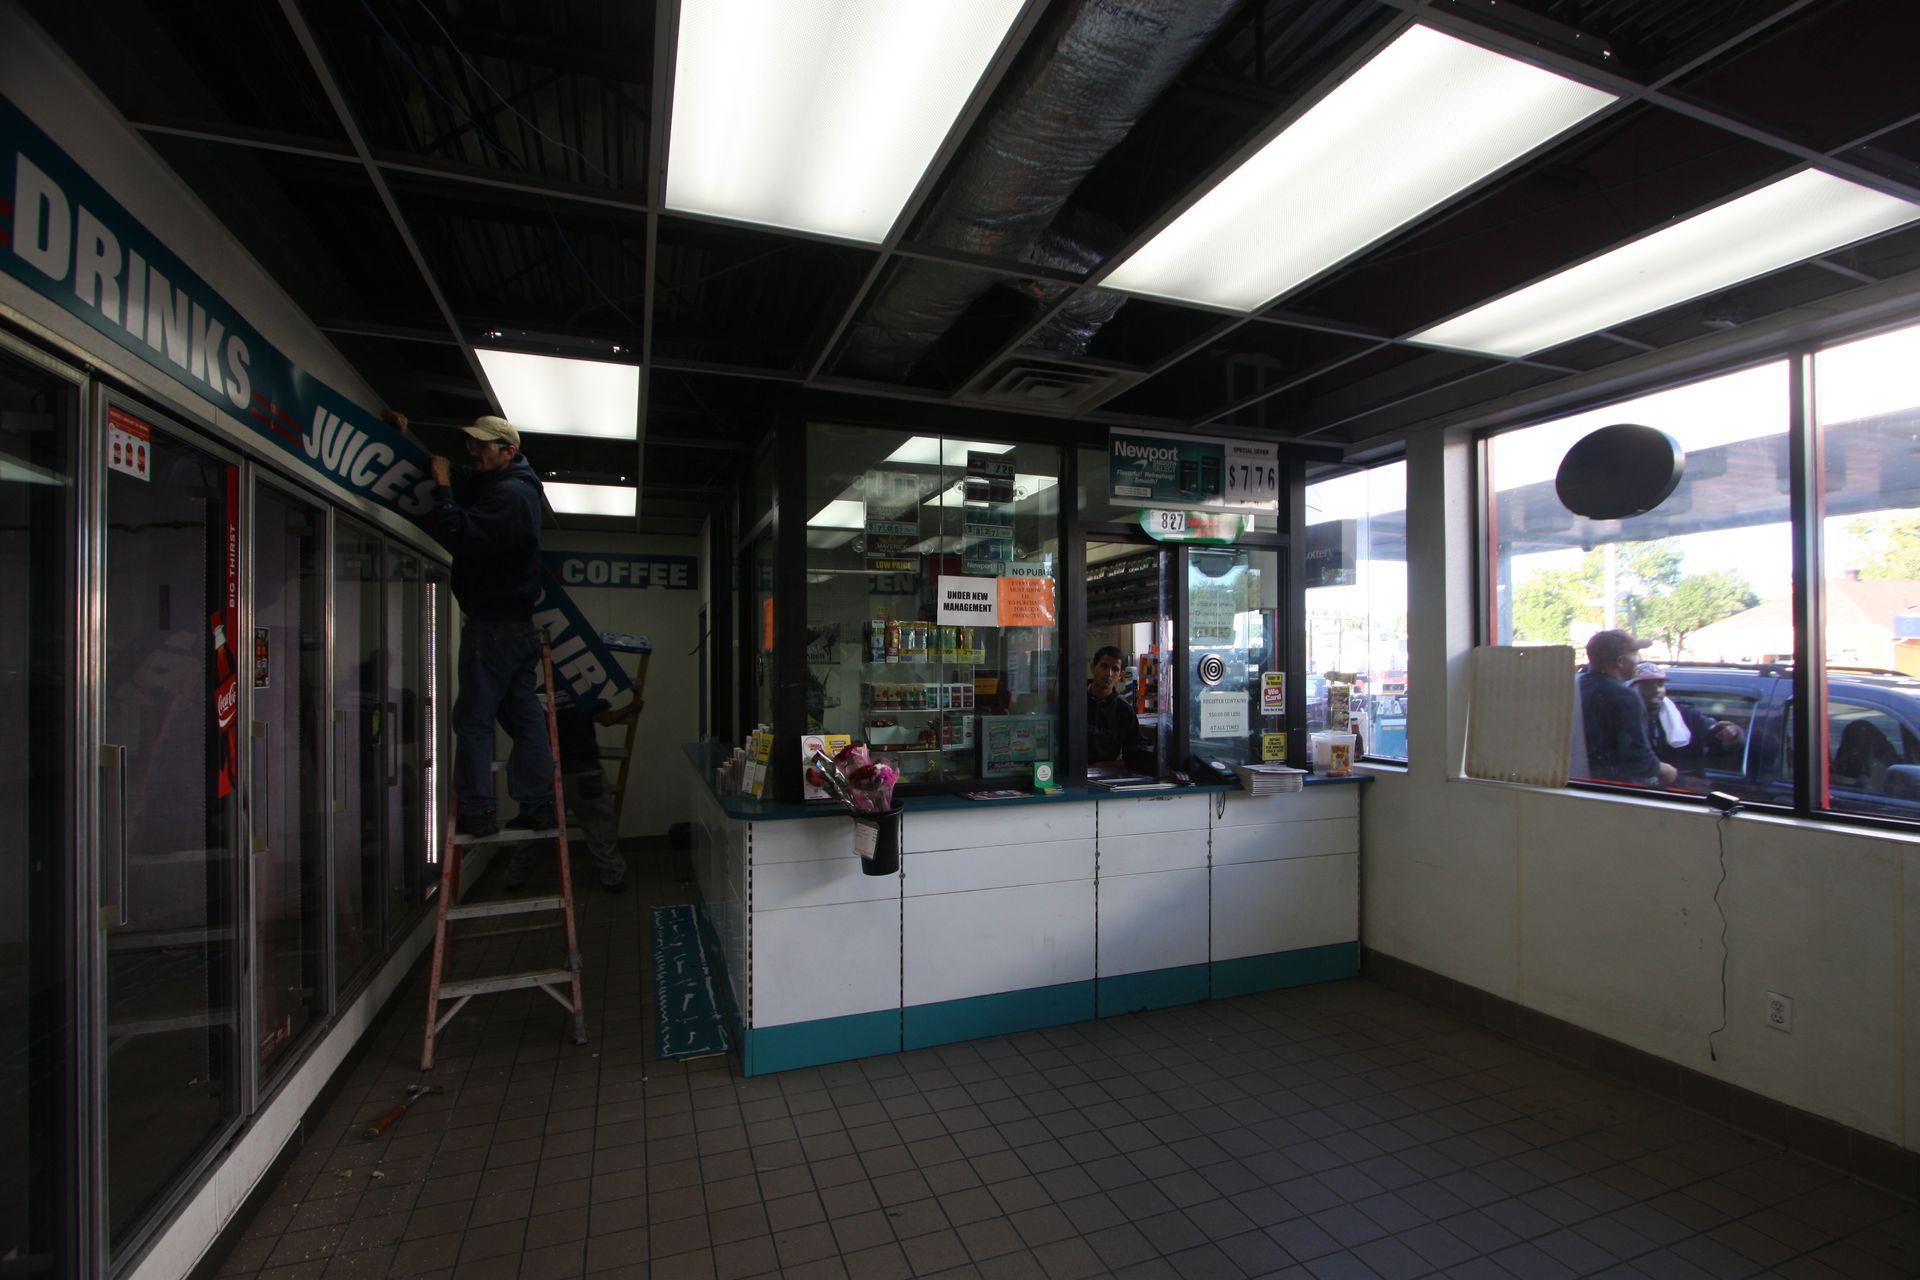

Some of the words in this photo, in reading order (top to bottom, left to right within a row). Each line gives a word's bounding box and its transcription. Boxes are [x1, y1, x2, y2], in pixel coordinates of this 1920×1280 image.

[12, 151, 251, 410] DRINKS
[302, 404, 437, 516] JUICES
[1114, 440, 1178, 462] Newport
[1161, 512, 1184, 530] 827
[1306, 547, 1335, 561] ottery
[562, 559, 688, 586] COFFEE
[1012, 568, 1025, 576] NO
[947, 591, 971, 600] UNDER
[972, 592, 988, 601] NEW
[943, 603, 992, 612] MANAGEMENT
[533, 587, 635, 712] AIRY
[1265, 693, 1282, 702] Card
